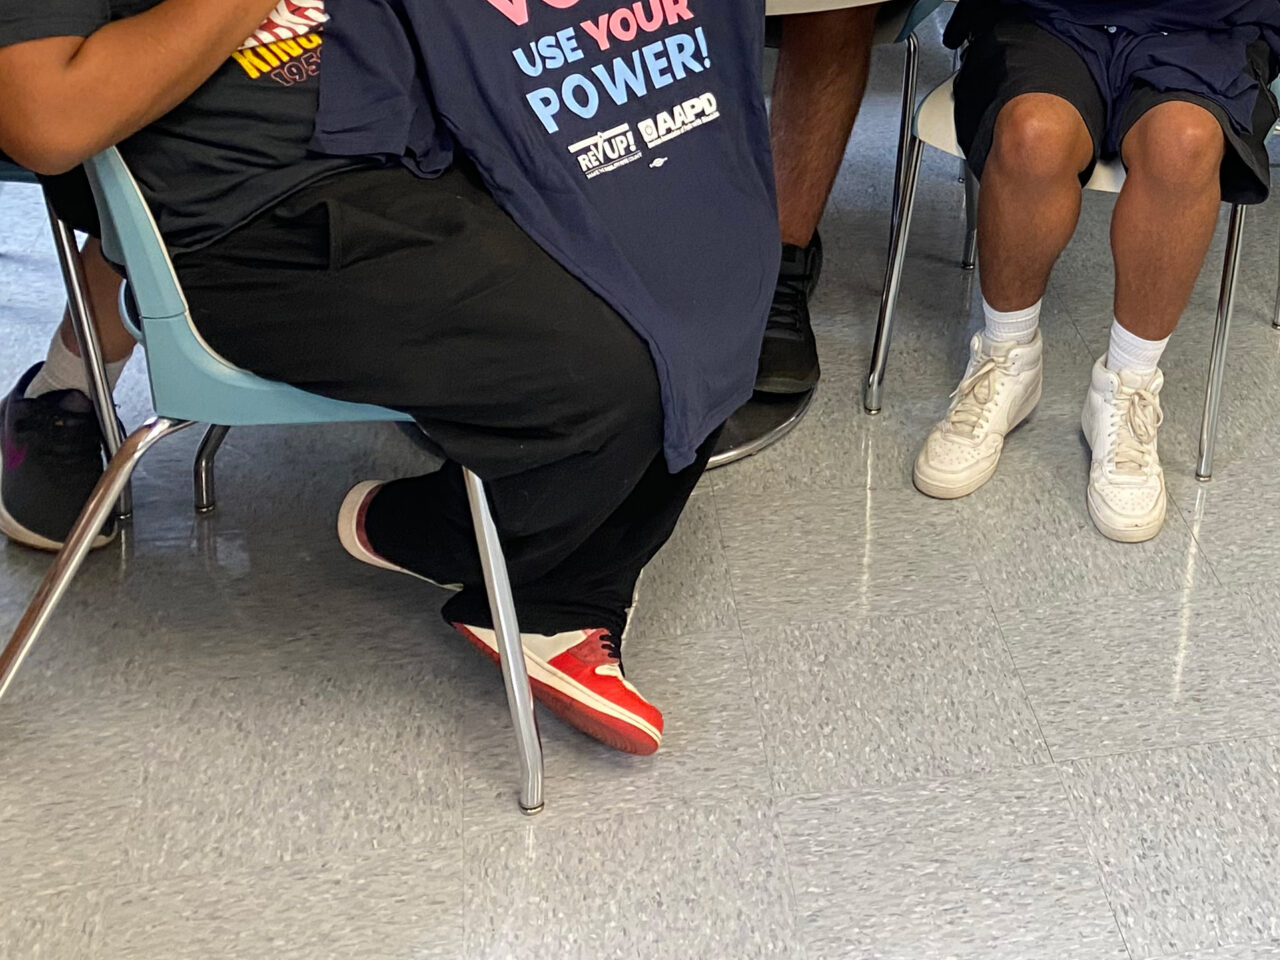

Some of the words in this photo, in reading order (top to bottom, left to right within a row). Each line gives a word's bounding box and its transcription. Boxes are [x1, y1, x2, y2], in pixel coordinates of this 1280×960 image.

[512, 26, 585, 77] USE
[525, 26, 712, 135] POWER!
[655, 92, 718, 136] AAPD
